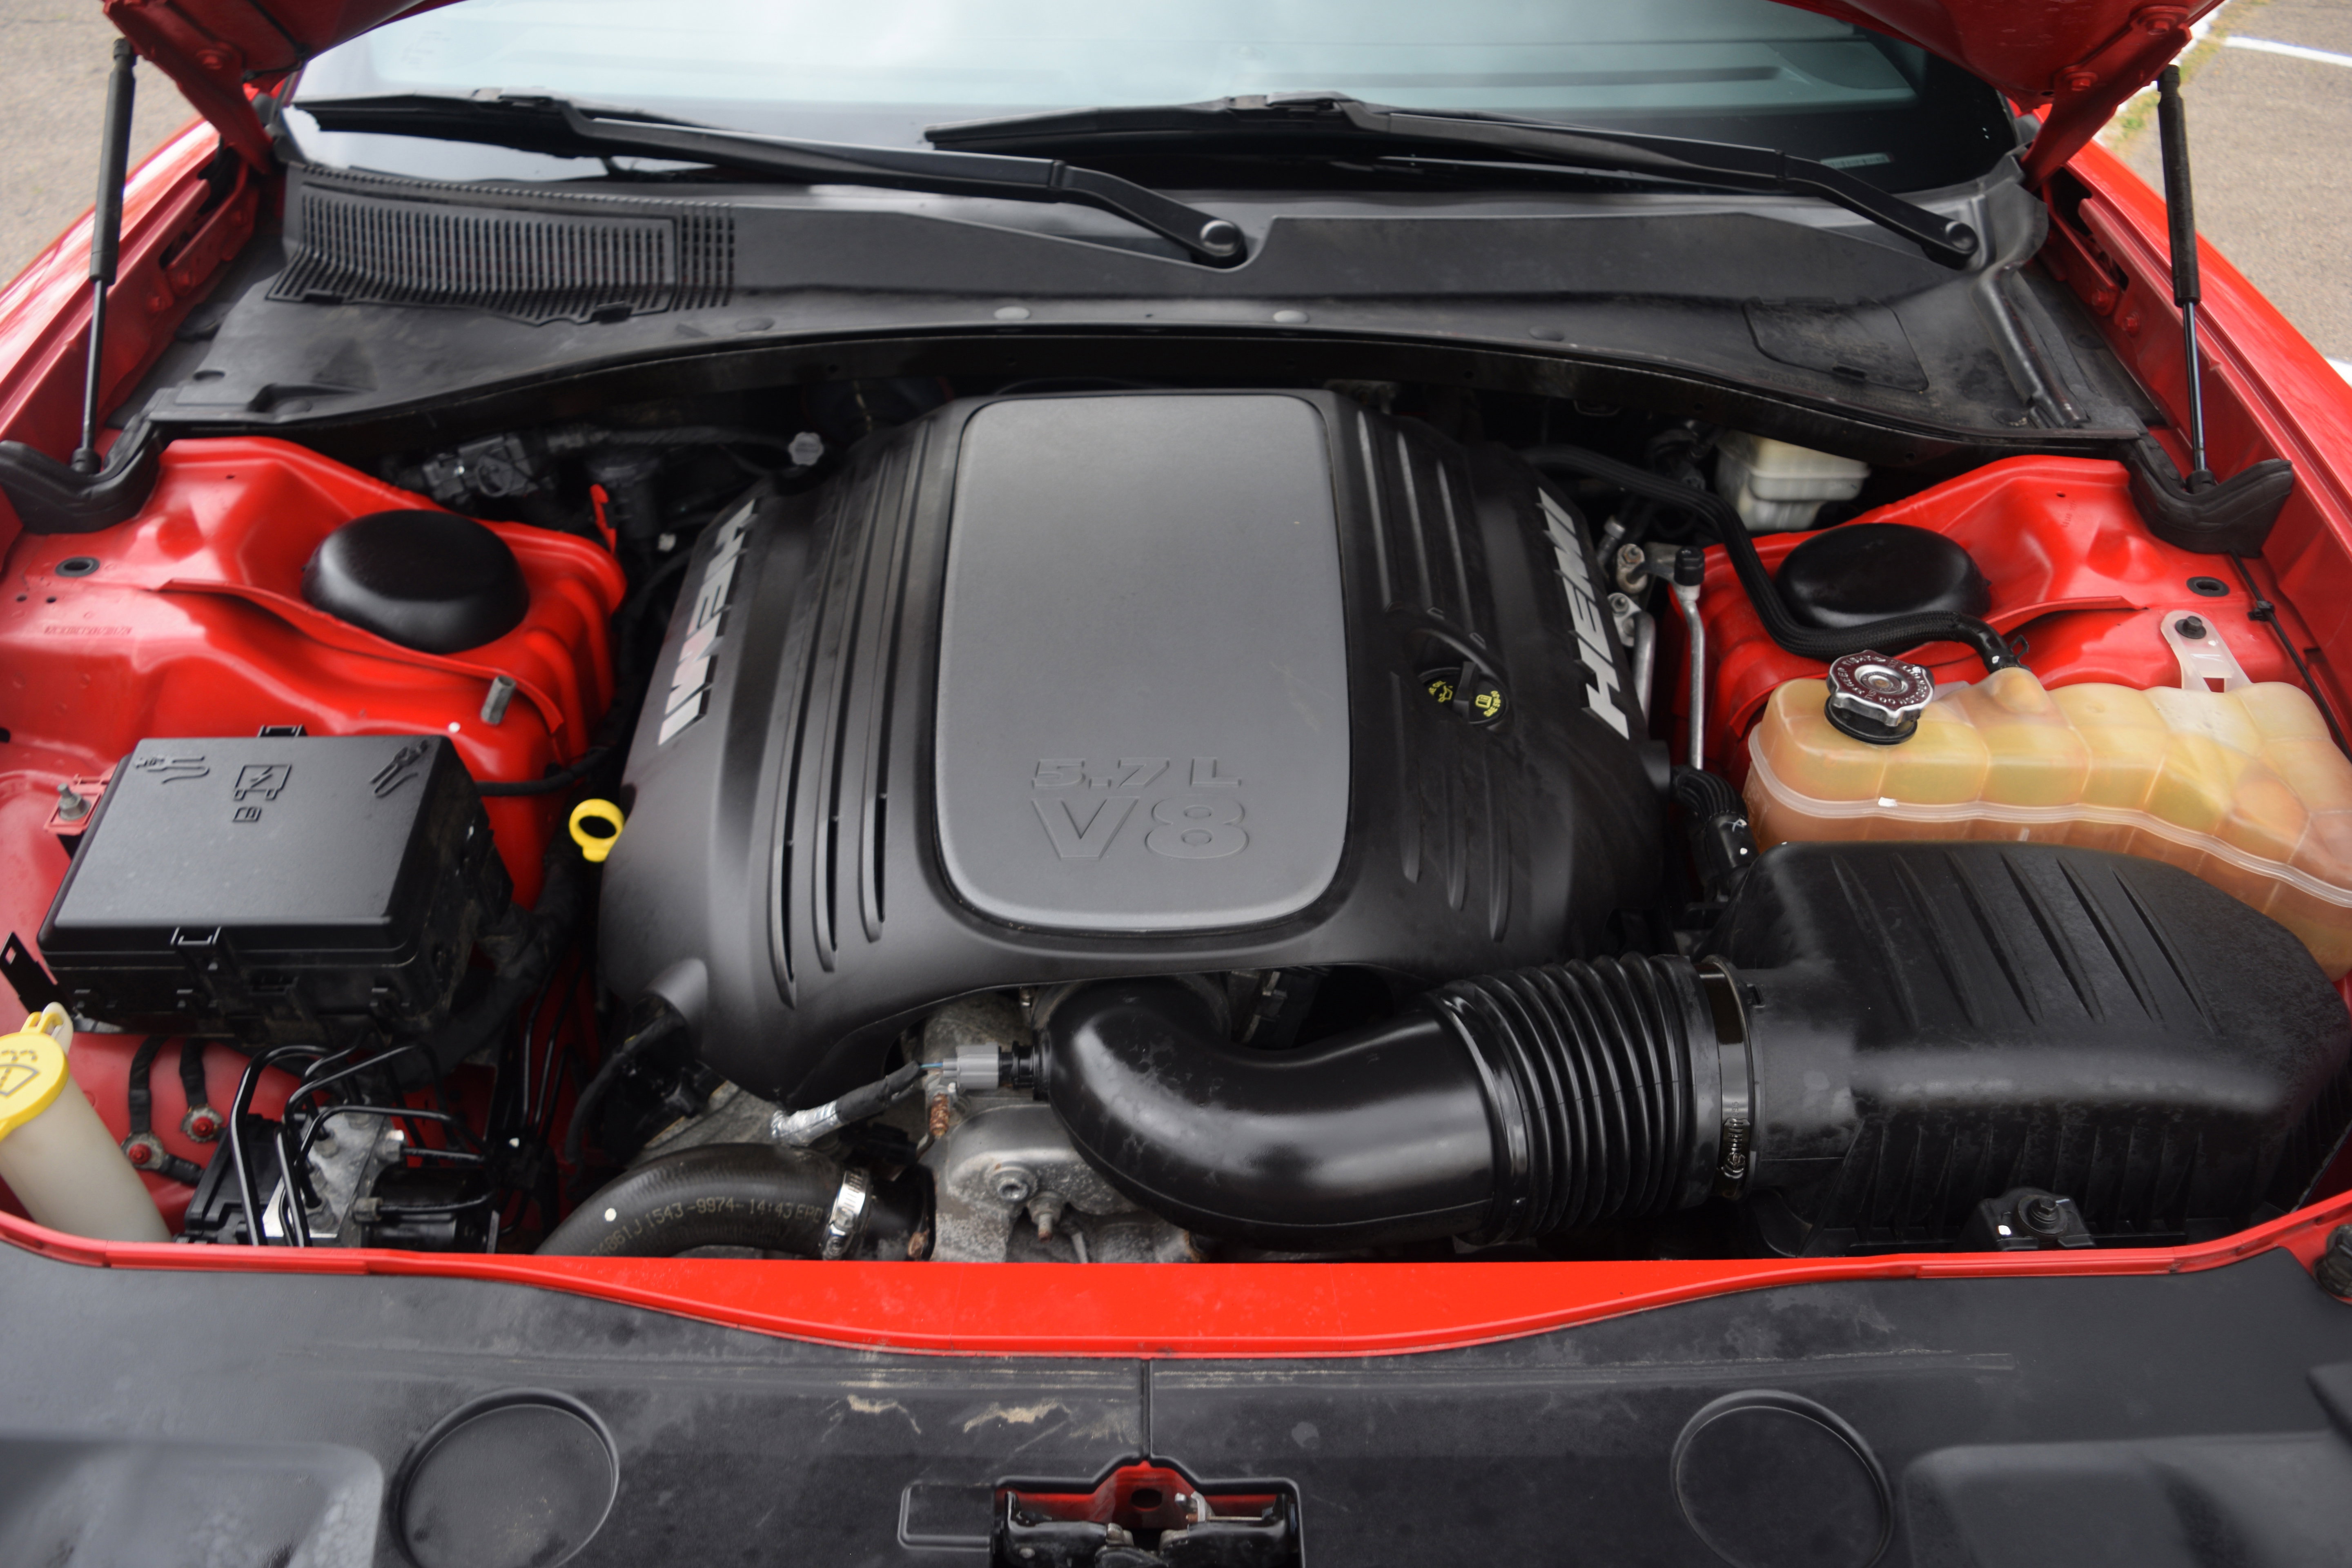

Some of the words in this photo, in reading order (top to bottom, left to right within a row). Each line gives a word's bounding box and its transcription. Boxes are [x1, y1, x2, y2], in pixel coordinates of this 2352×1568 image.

[658, 499, 757, 746] HEMI
[1538, 487, 1629, 739] HEMI
[1842, 655, 1871, 666] TIGHT
[1483, 706, 1498, 717] SAE
[1879, 696, 1896, 704] DO
[1898, 695, 1919, 705] NOT
[1031, 794, 1250, 860] V8
